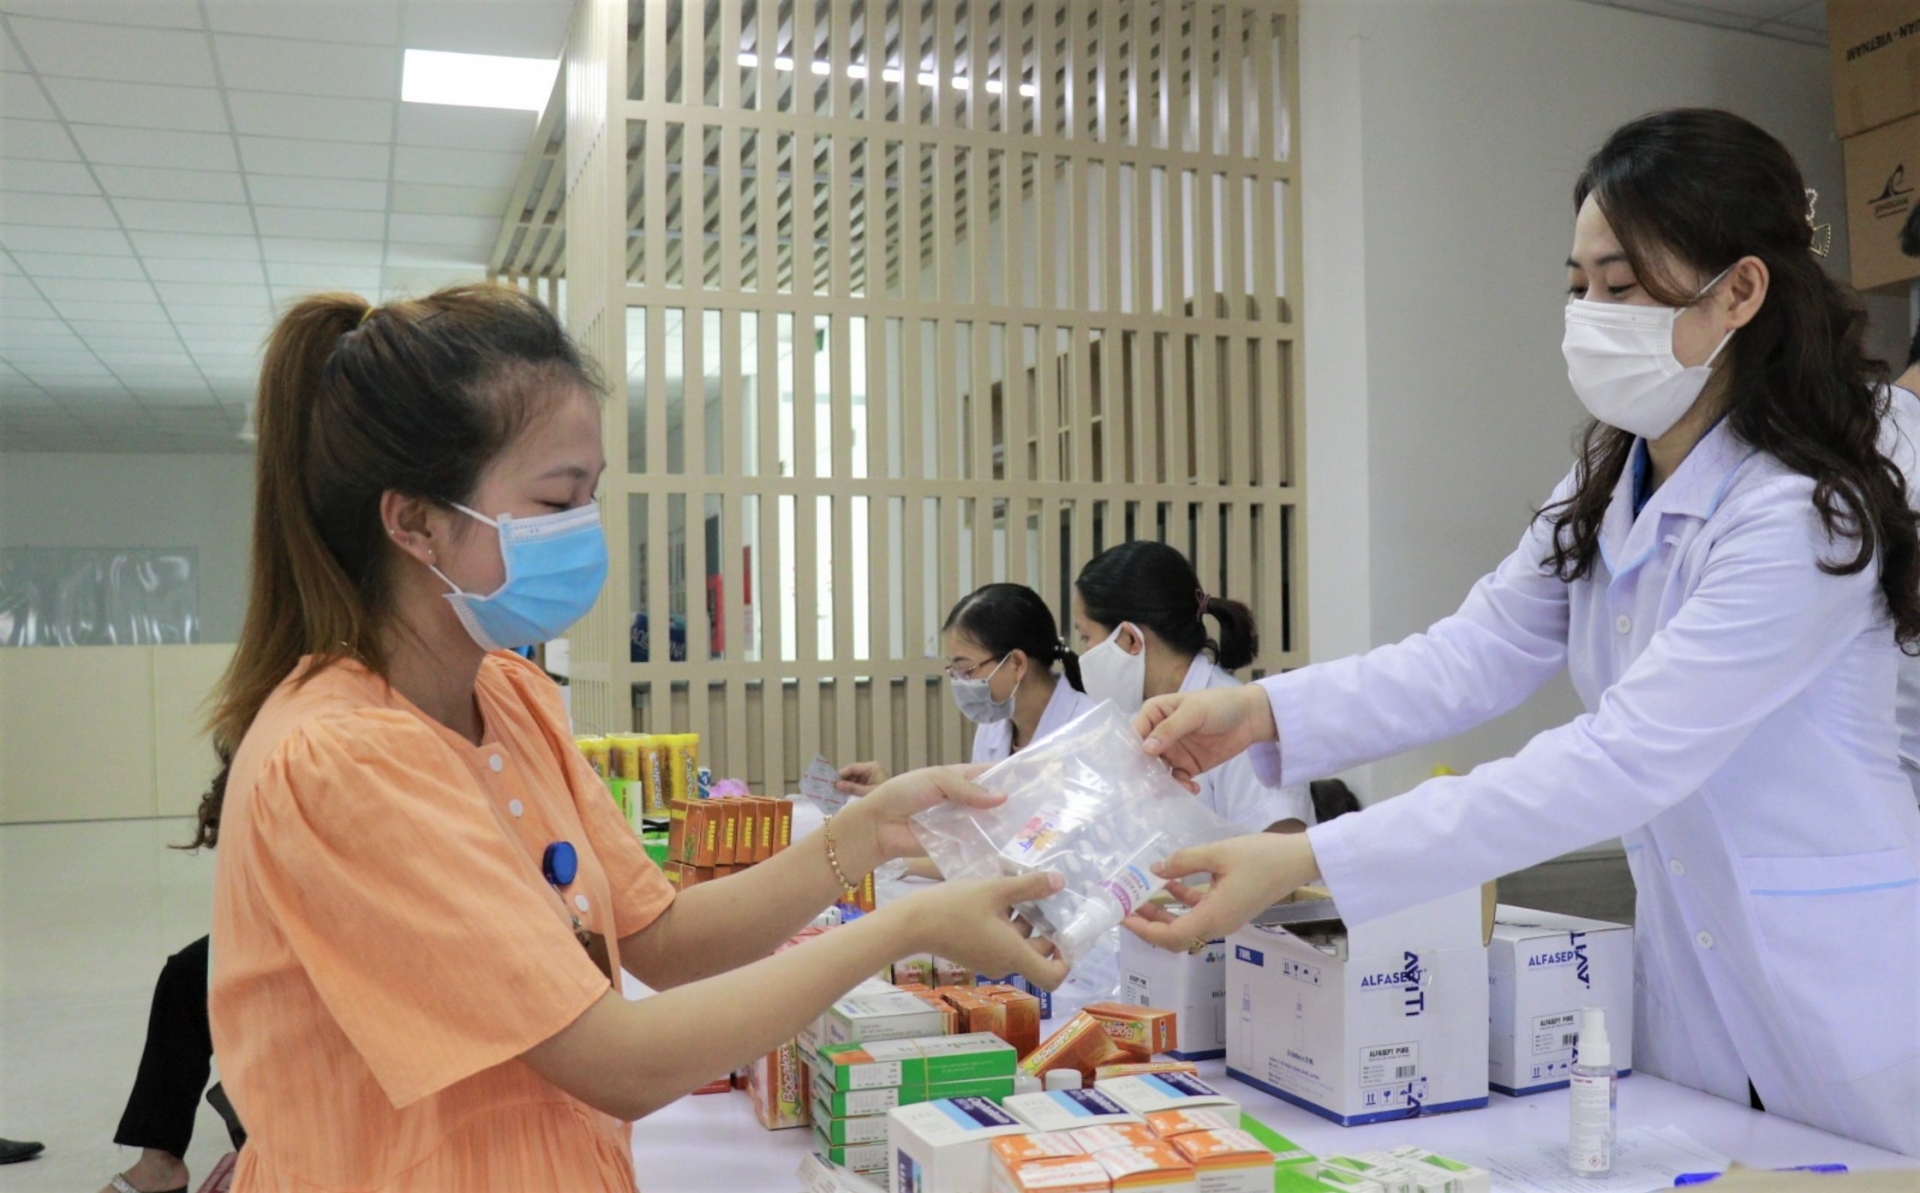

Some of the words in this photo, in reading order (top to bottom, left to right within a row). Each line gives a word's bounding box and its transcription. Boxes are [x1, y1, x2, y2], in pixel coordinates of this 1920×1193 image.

[707, 820, 716, 851] BOGANIC
[727, 818, 735, 849] BOGANIC
[745, 817, 753, 848] BOGANIC
[1528, 950, 1579, 967] ALFASEPT
[1361, 969, 1421, 988] ALFASEPT
[782, 1048, 796, 1102] Bocalex
